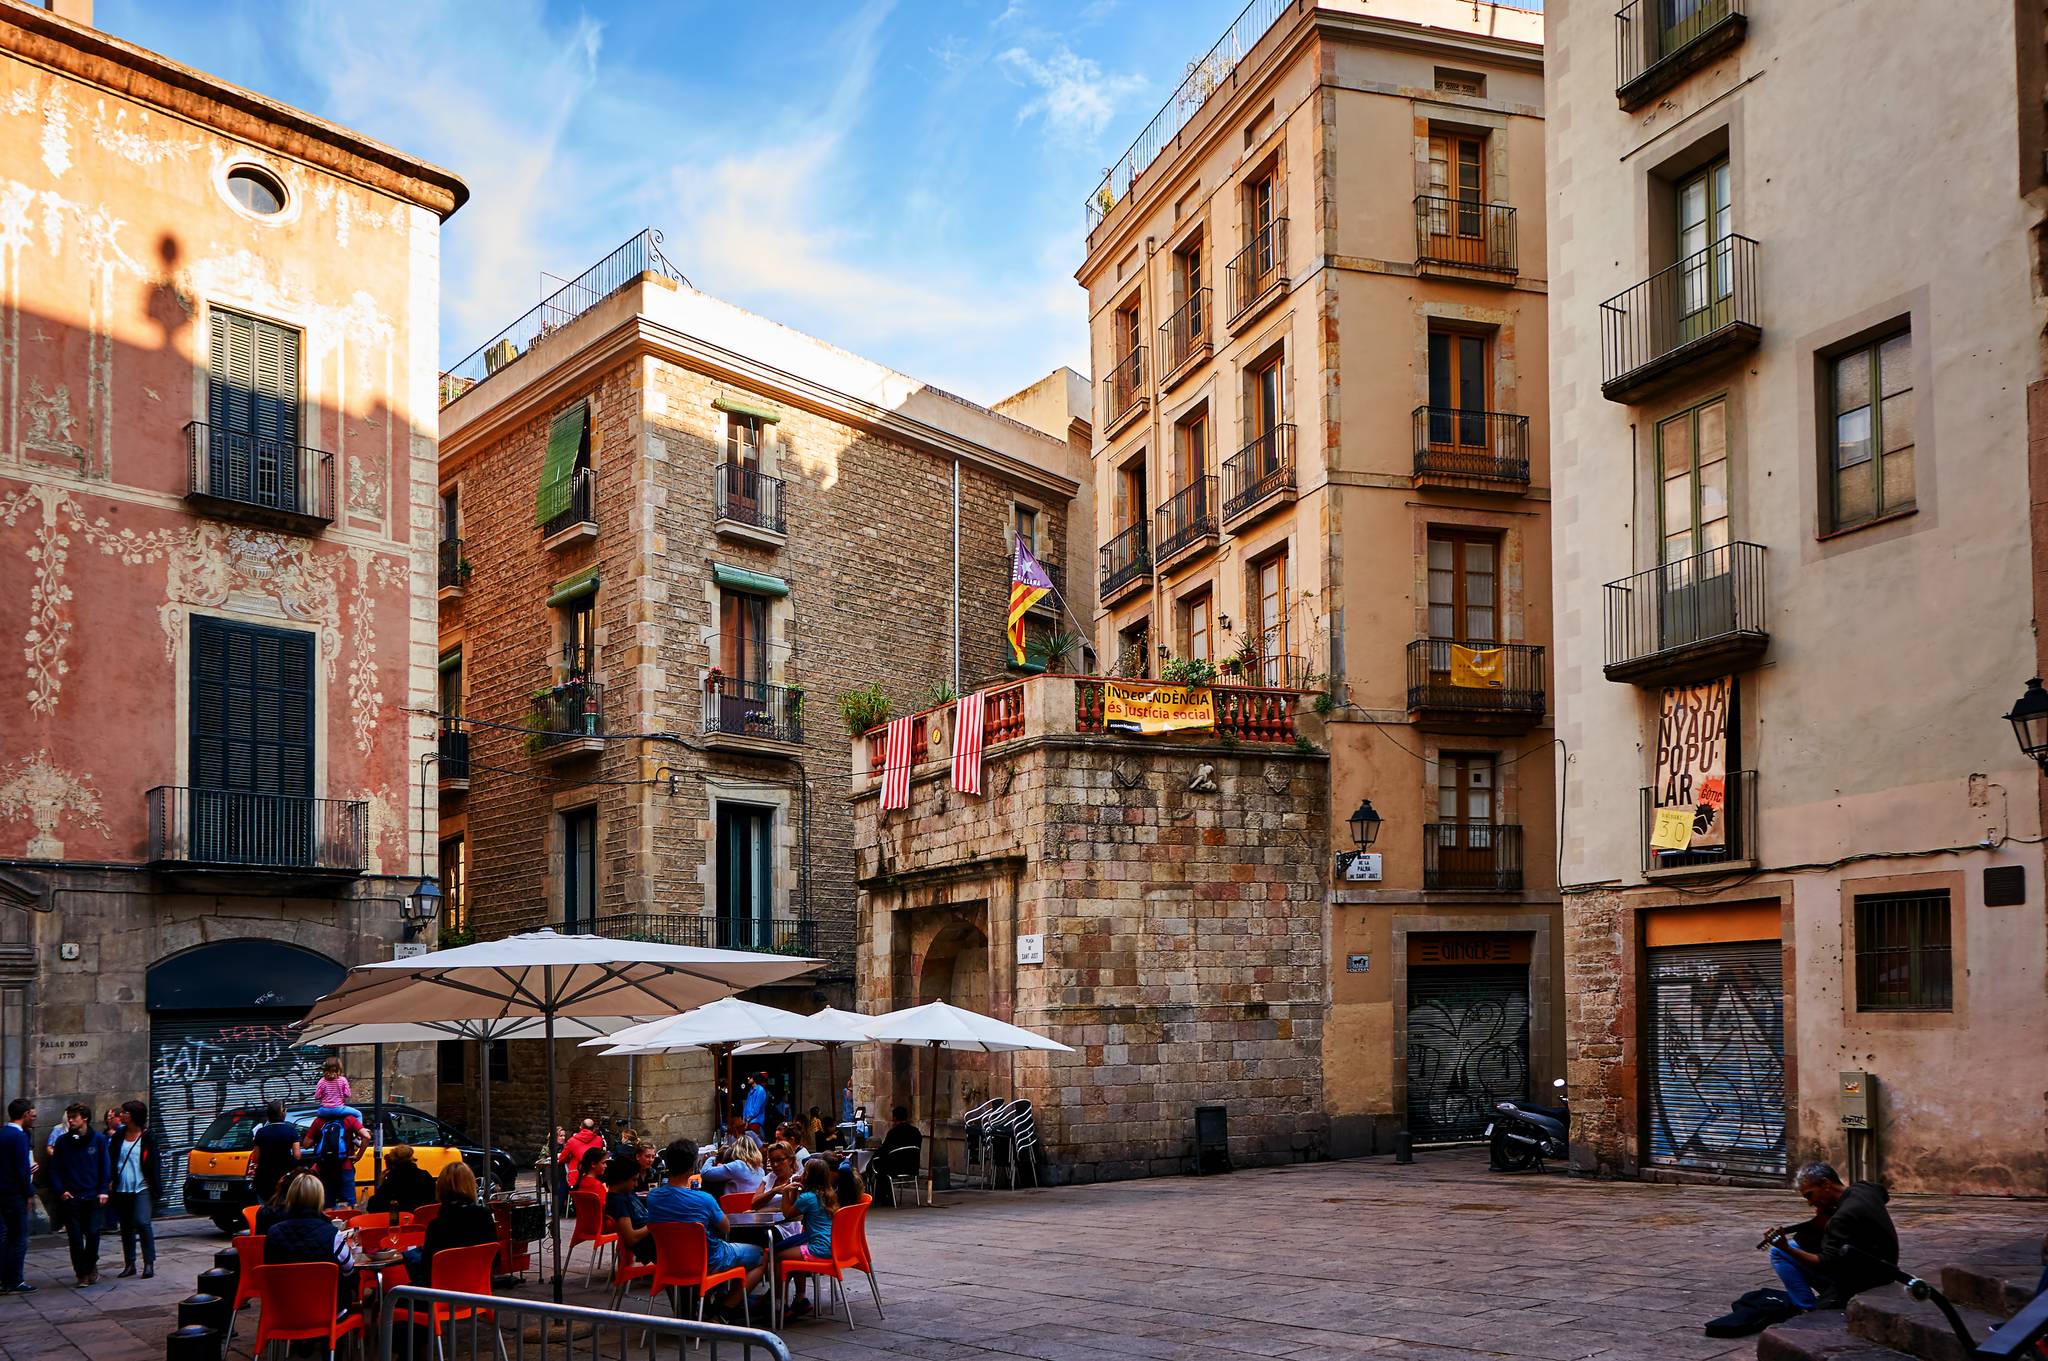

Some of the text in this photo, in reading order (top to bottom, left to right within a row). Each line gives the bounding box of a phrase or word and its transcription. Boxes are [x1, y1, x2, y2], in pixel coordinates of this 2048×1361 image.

[1107, 685, 1210, 705] INDEPENDÈNCIA
[1108, 701, 1211, 720] és justícia social
[1658, 706, 1727, 748] NYADA
[1654, 774, 1692, 808] LAR
